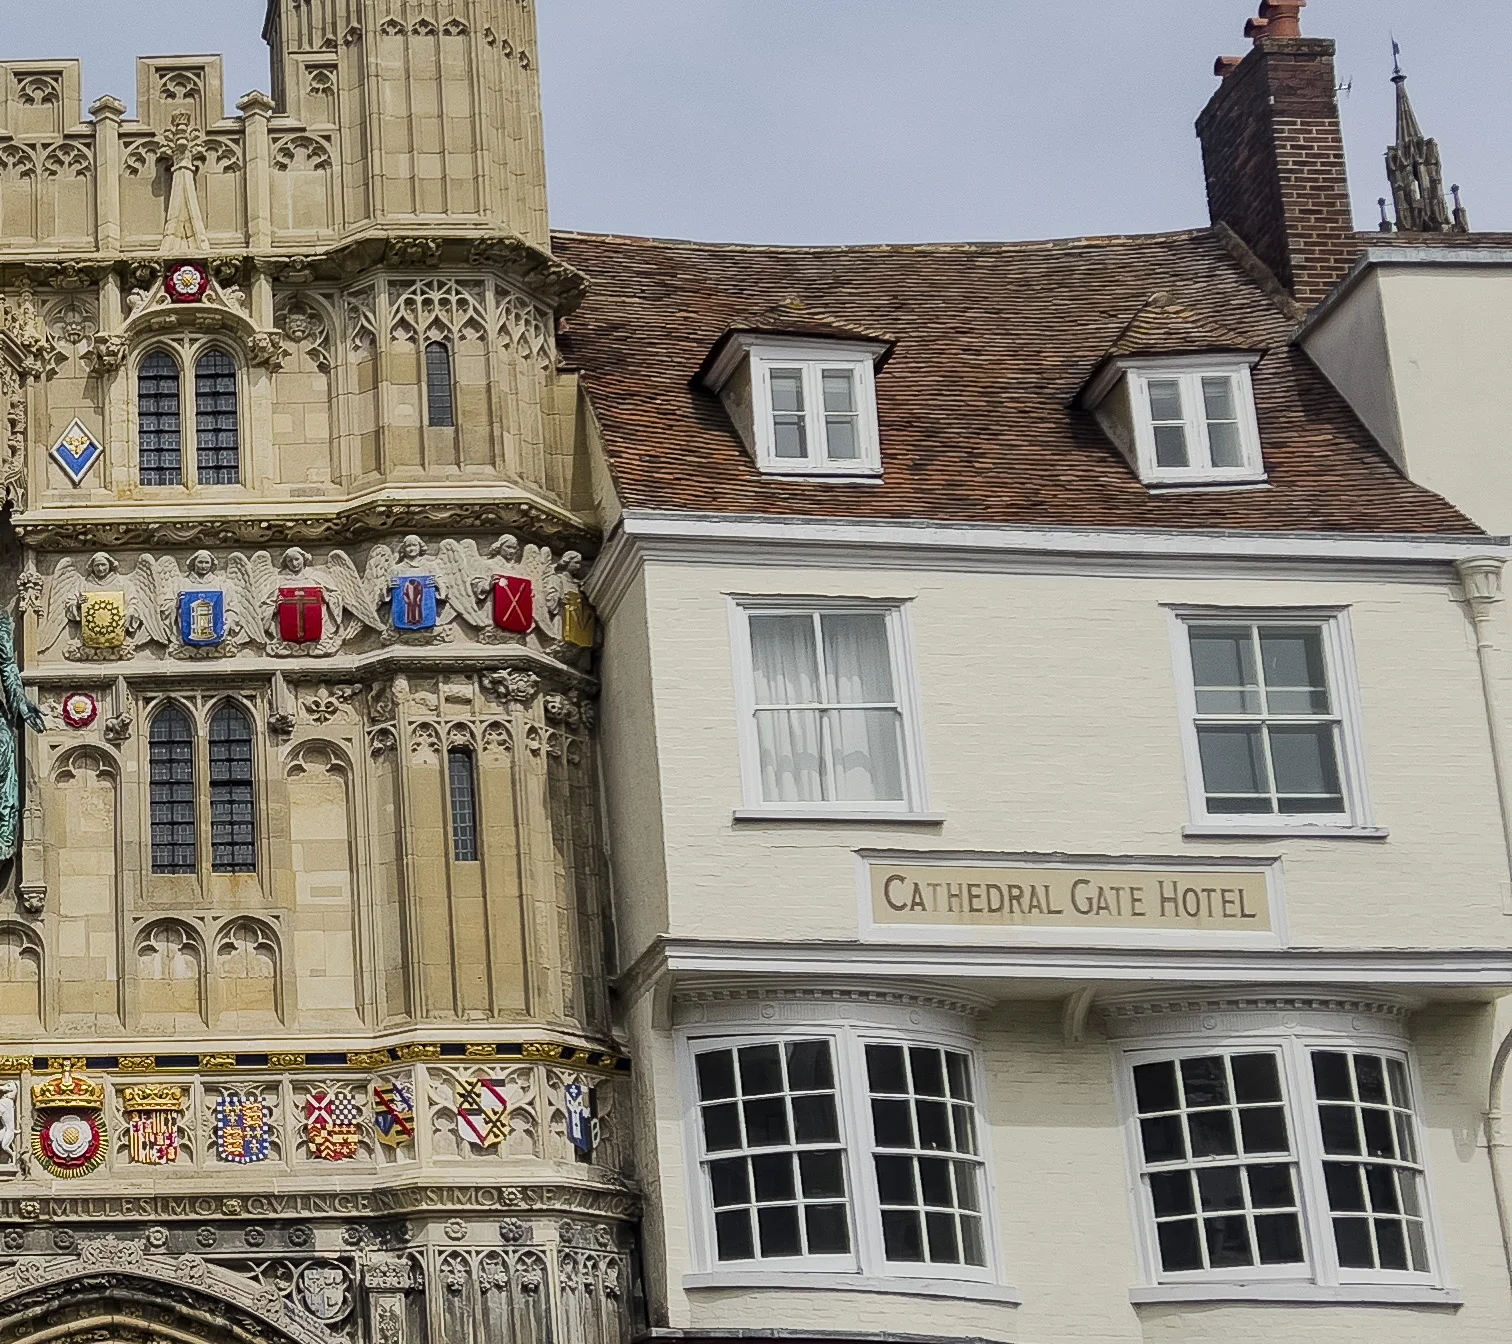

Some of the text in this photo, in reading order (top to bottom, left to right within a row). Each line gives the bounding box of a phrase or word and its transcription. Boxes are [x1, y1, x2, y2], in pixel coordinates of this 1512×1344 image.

[883, 873, 1257, 919] CATHEDRAL GATE HOTEL
[49, 1197, 216, 1218] MILLESIMO
[246, 1187, 499, 1215] QVINGENTESIMO
